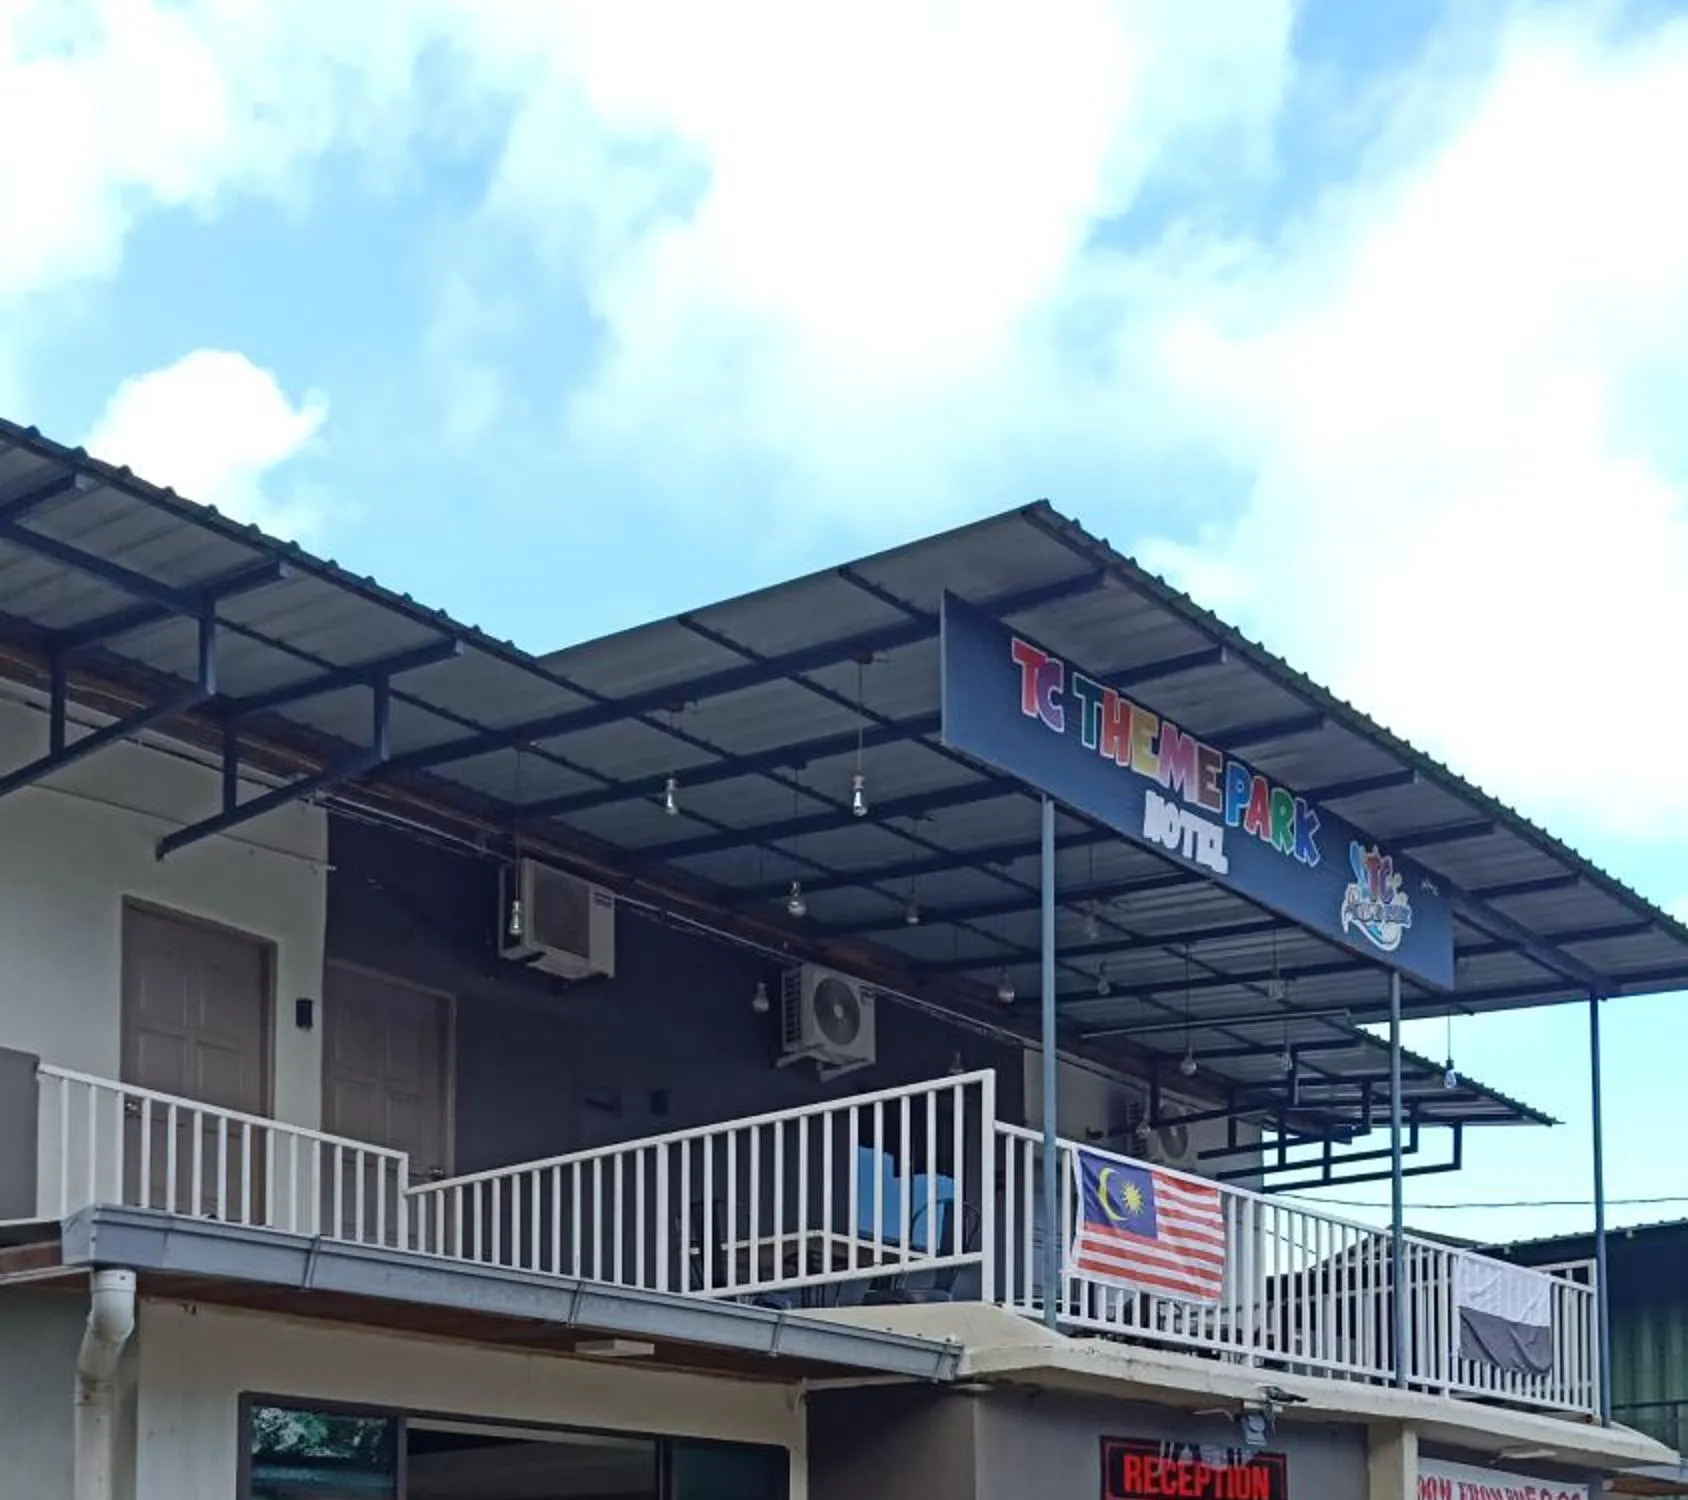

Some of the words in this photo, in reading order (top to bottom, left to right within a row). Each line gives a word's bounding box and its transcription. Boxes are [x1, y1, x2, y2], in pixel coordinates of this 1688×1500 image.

[1011, 636, 1065, 733] TC
[1072, 671, 1223, 813] THEME
[1225, 760, 1321, 868] PARK
